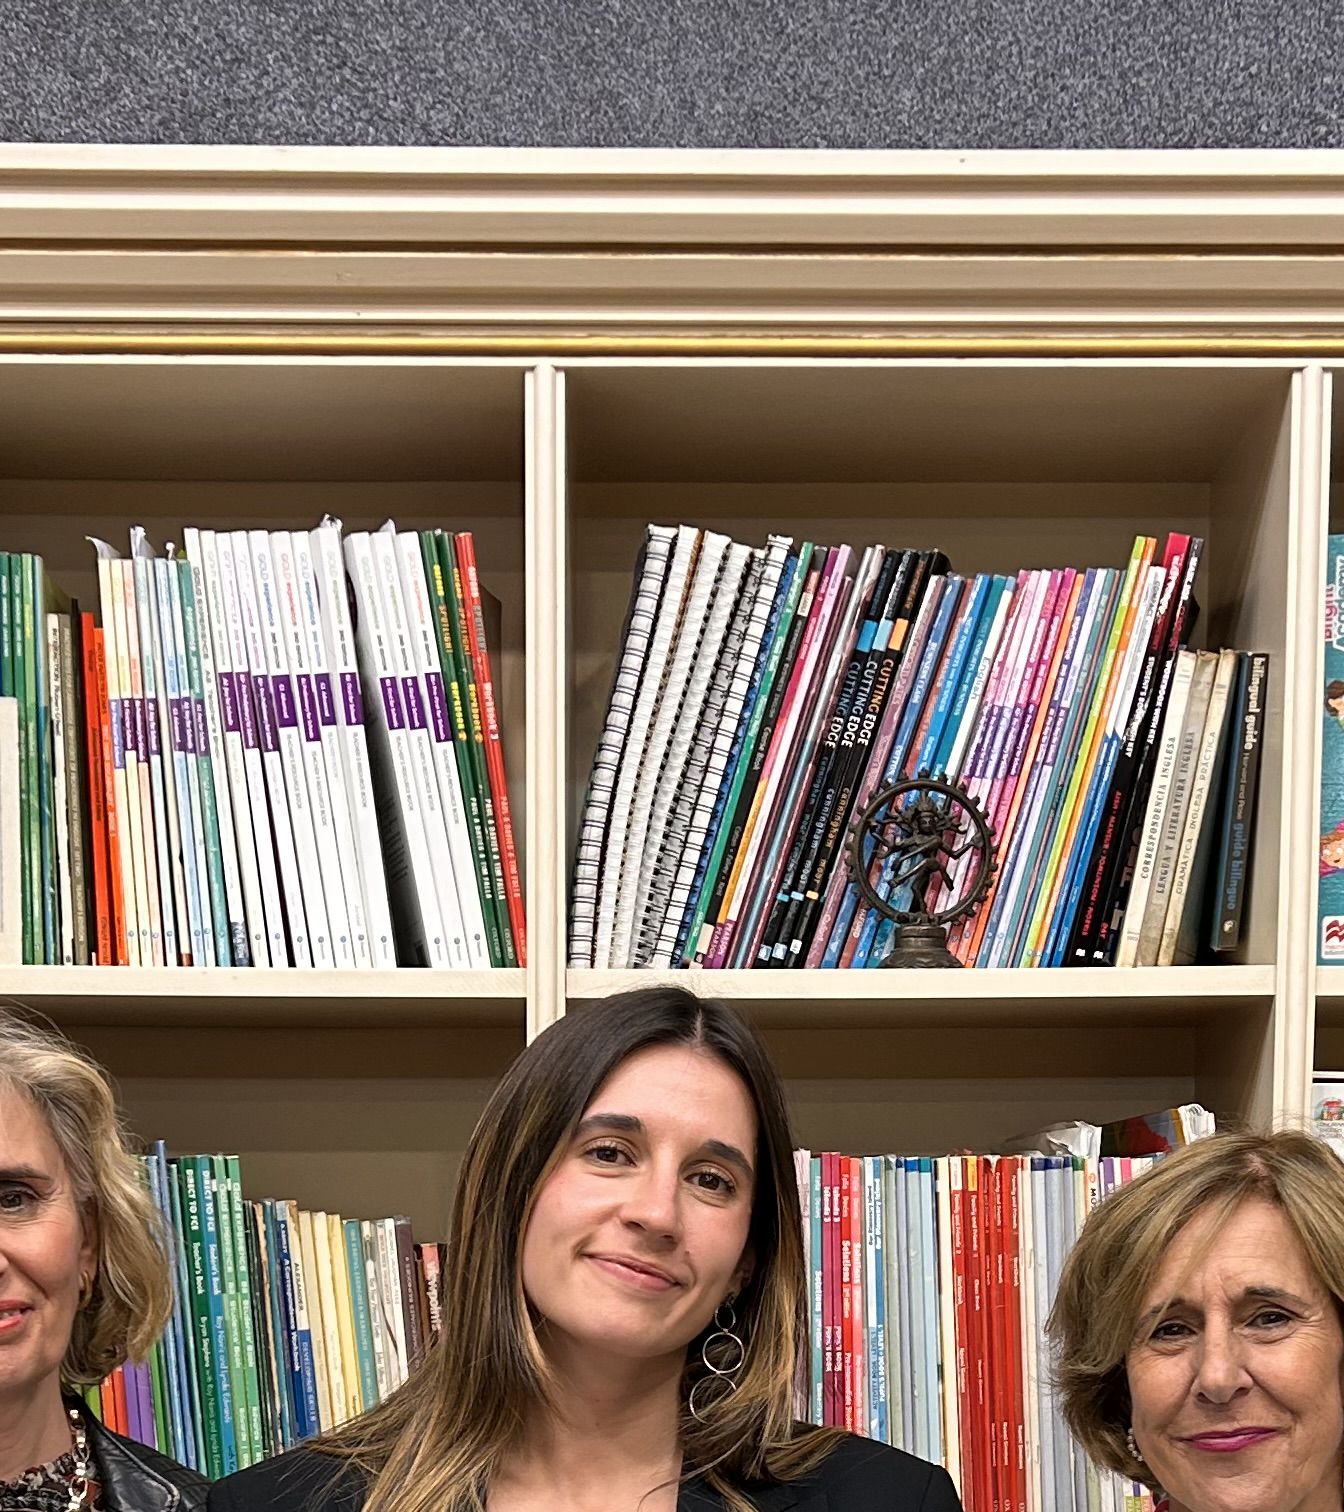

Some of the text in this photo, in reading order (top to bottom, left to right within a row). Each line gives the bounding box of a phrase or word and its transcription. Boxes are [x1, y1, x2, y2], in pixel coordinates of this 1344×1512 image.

[840, 659, 878, 748] CUTTING EDGE
[857, 658, 894, 746] CUTTING EDGE
[970, 656, 992, 701] English
[1244, 656, 1266, 750] bilingual guide
[1140, 736, 1176, 880] CORRESPONDENCIA INGLESA
[1155, 856, 1172, 895] LENGUA
[1167, 779, 1187, 842] LITERATURA
[1179, 731, 1196, 776] INGLESA
[185, 1169, 199, 1231] DIRECT TO FCE
[202, 1170, 216, 1232] DIRECT TO FCE
[842, 1240, 851, 1283] Solutions
